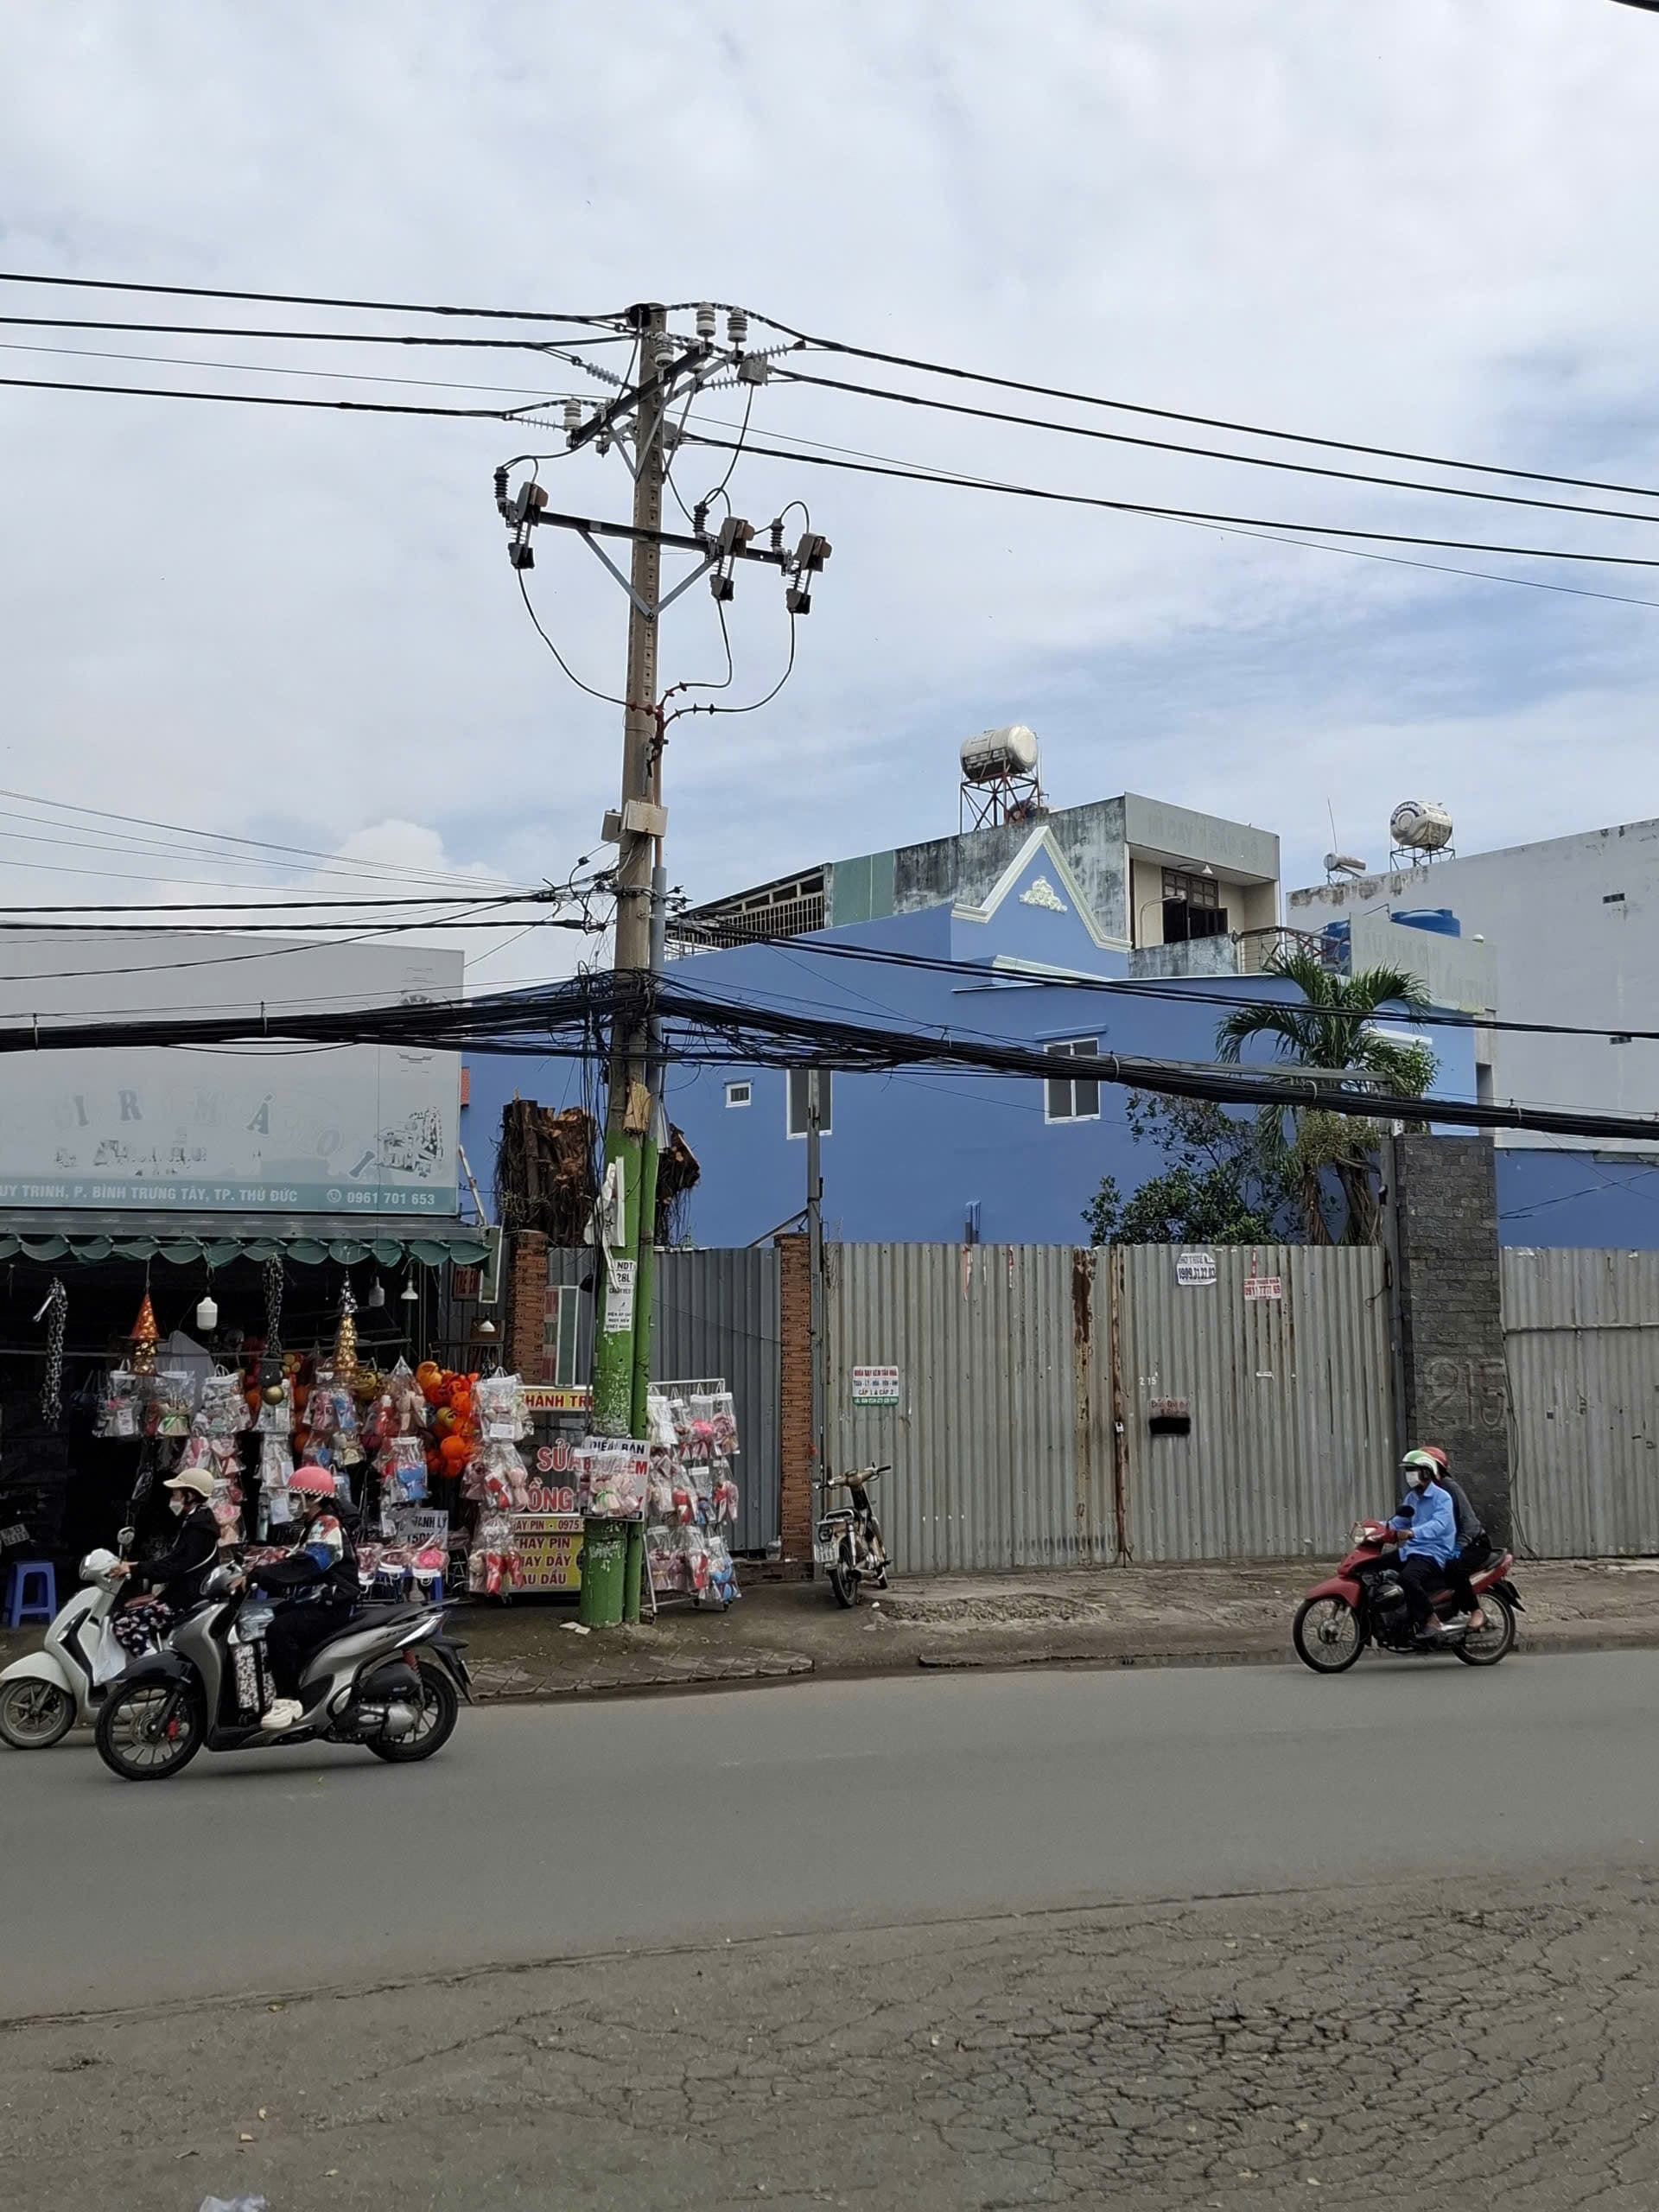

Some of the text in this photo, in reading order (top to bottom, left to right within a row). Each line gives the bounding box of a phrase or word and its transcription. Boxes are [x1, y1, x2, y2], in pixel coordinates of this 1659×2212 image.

[22, 1185, 69, 1199] TRINH,
[73, 1185, 86, 1198] P.
[92, 1184, 125, 1199] BÌNH
[131, 1186, 176, 1200] TRƯNG
[181, 1185, 209, 1202] TÂY,
[214, 1188, 234, 1201] TP.
[239, 1186, 266, 1202] THỦ
[270, 1188, 297, 1202] ĐỨC
[347, 1192, 435, 1205] 0961 701 653
[525, 1392, 564, 1408] HÀNH
[517, 1519, 580, 1530] AY PIN 0975
[549, 1537, 570, 1549] PIN
[546, 1552, 571, 1567] DÂY
